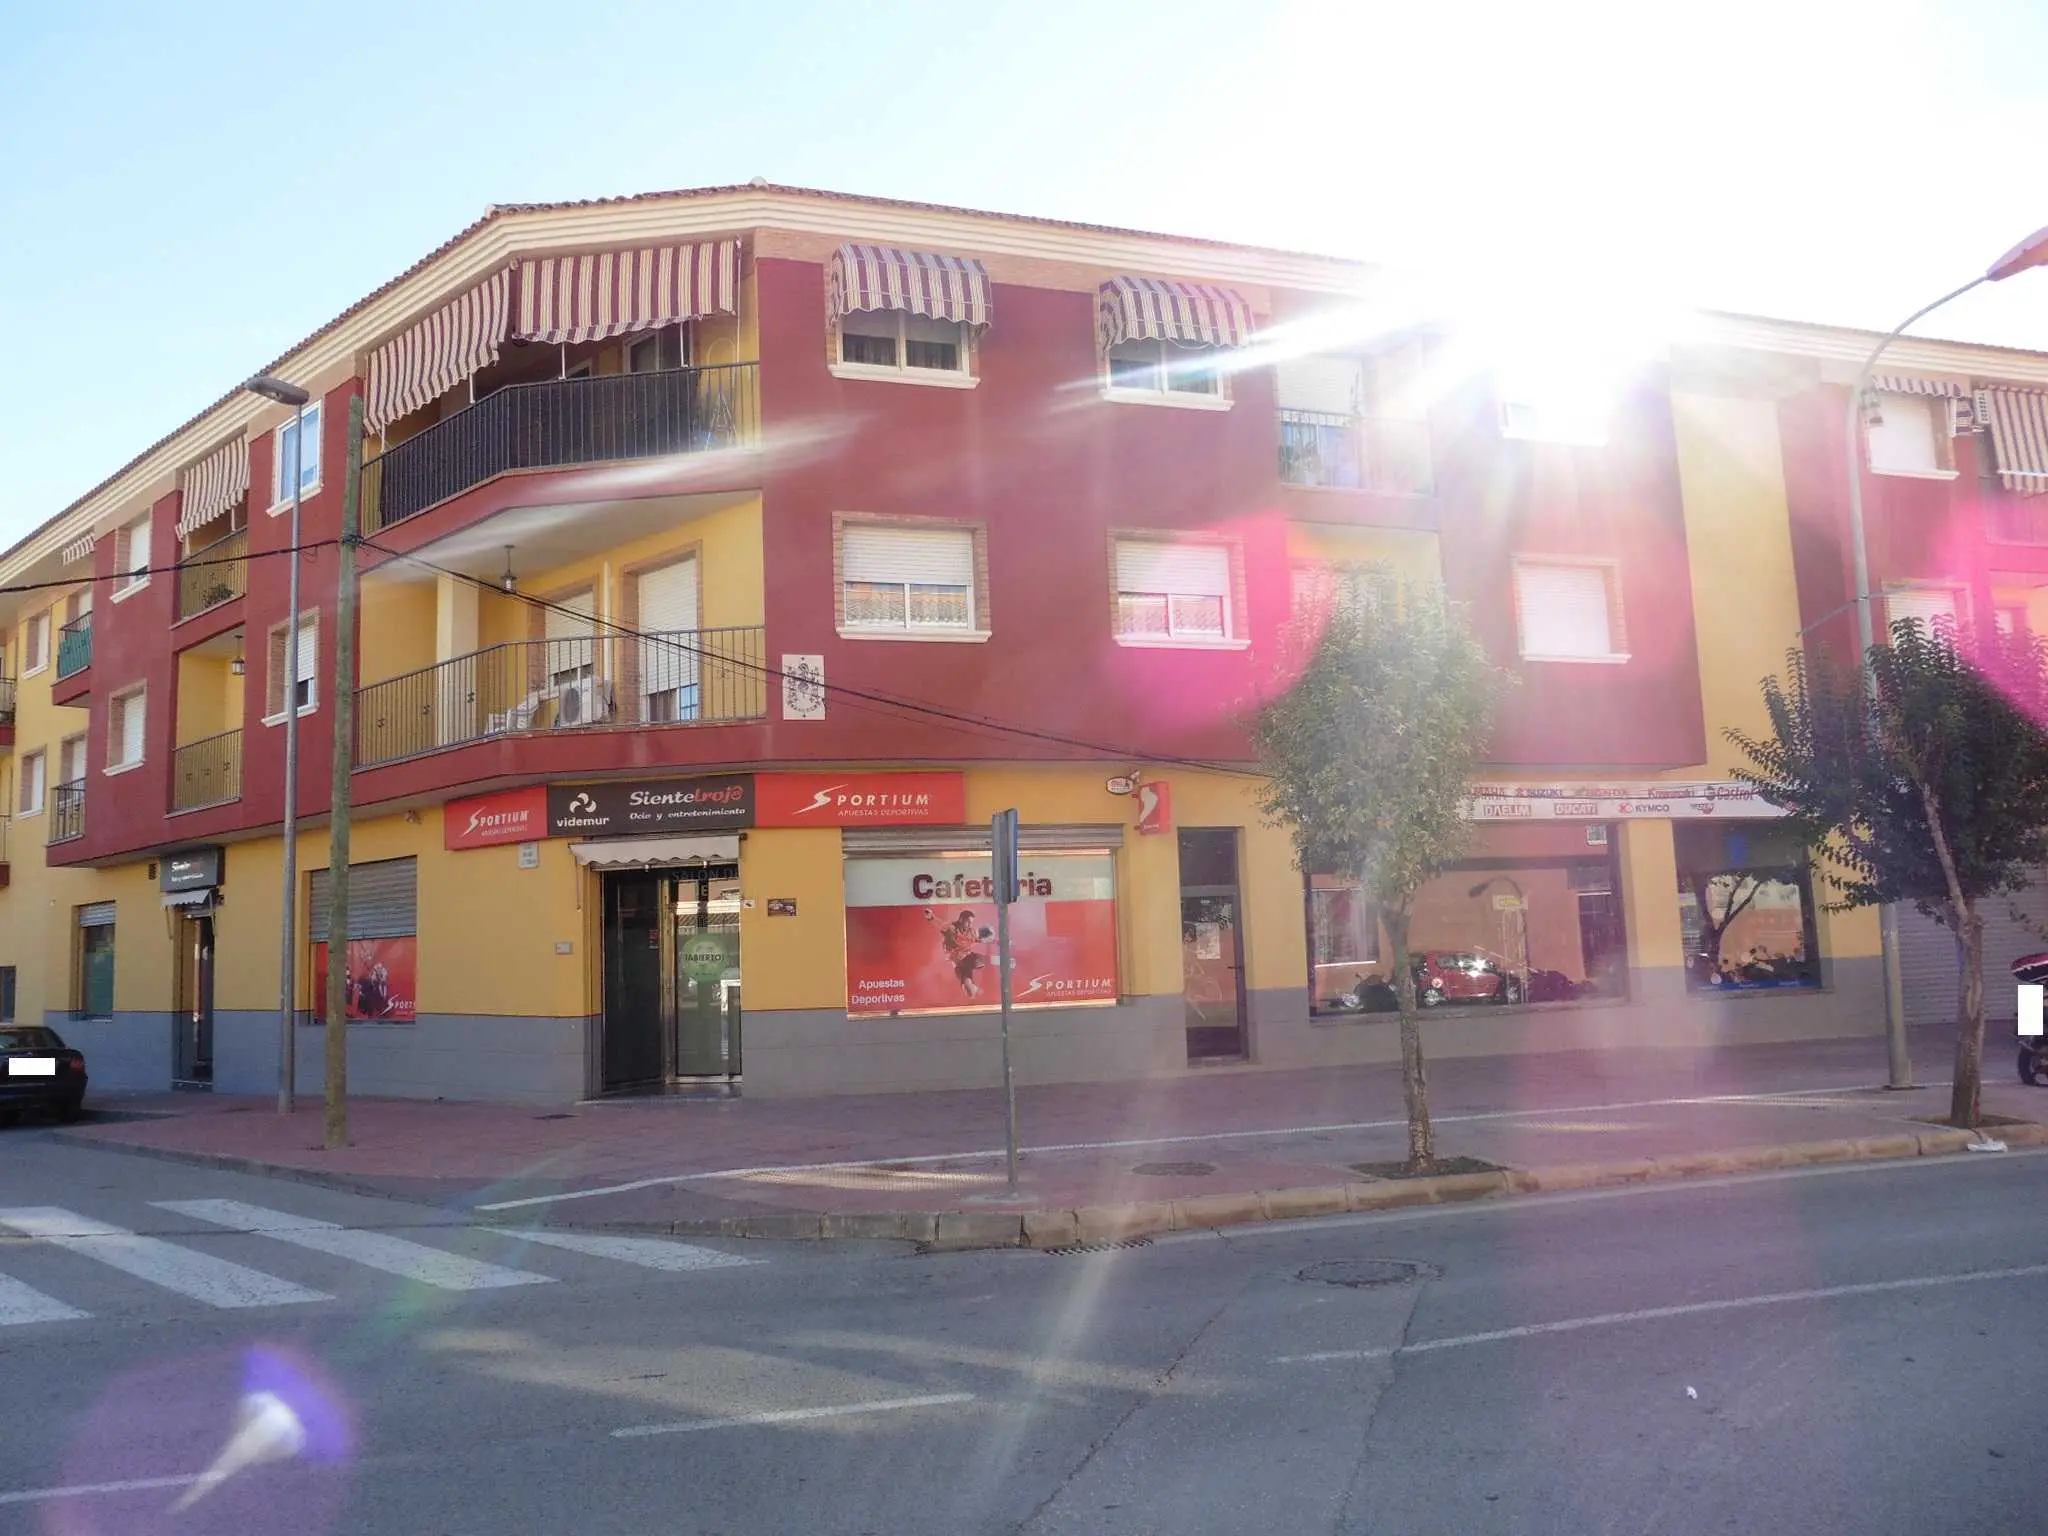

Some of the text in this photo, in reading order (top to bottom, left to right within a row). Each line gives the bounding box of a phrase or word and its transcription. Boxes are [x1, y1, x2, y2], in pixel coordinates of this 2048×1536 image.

[792, 784, 929, 815] SPORTIUM
[656, 813, 663, 821] y
[668, 808, 746, 818] entretenimiento
[1635, 804, 1670, 813] KYMCO
[461, 805, 530, 838] SPORTIUM
[556, 817, 610, 828] videmur
[912, 872, 1053, 900] Cafetria
[859, 979, 905, 991] Apuestas
[1016, 973, 1112, 997] SPORTIUM
[851, 993, 905, 1005] Deportivas
